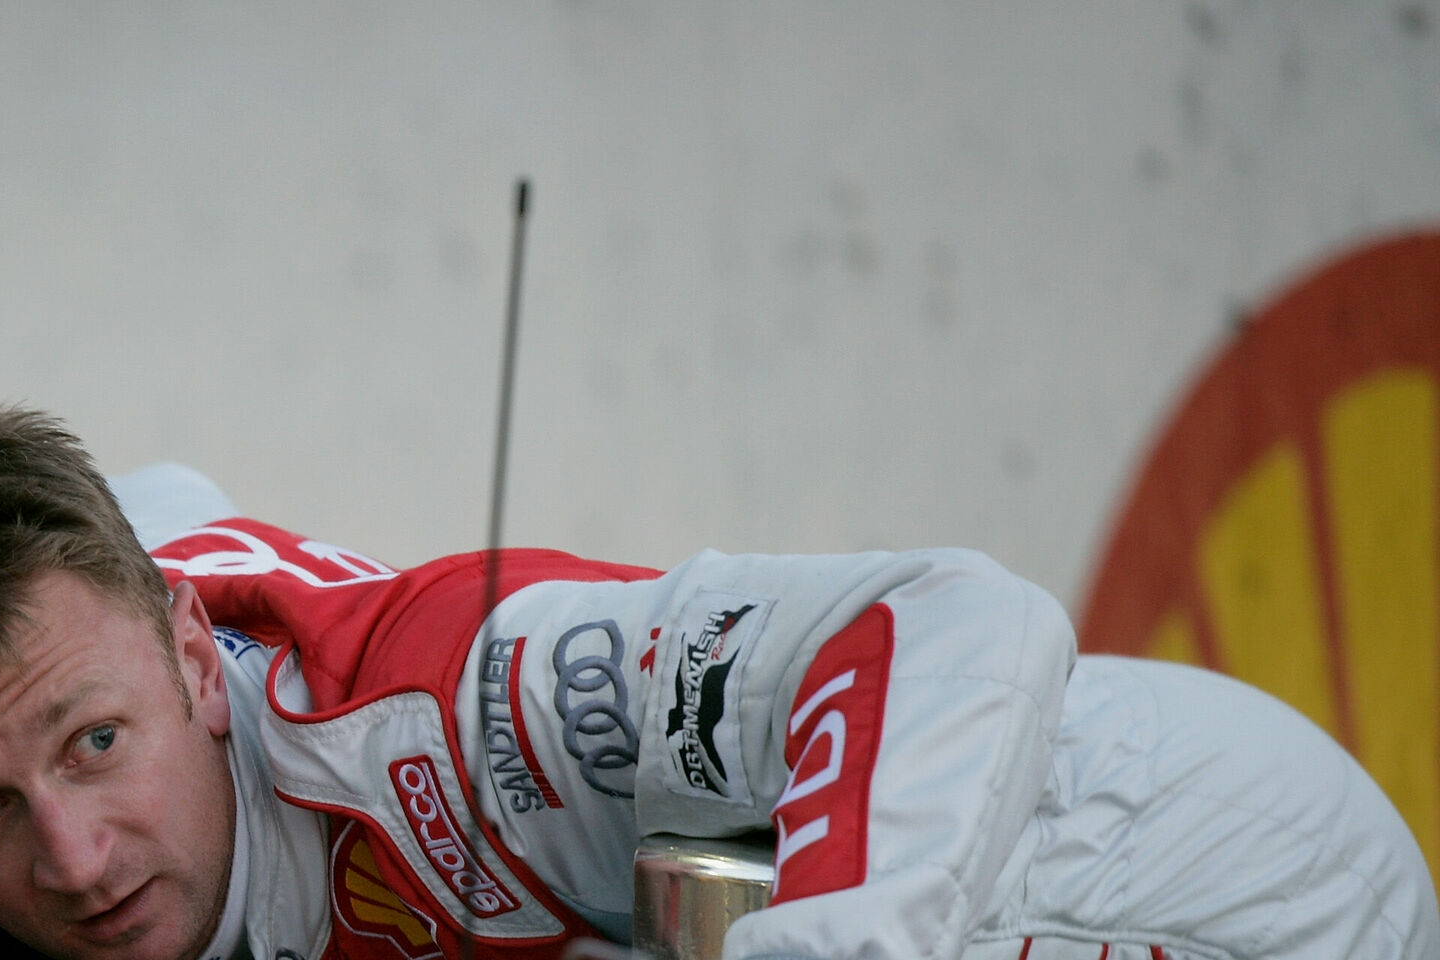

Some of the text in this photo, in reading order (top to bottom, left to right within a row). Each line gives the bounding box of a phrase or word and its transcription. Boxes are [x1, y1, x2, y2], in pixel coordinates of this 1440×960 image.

[480, 637, 546, 814] SANDTLER
[770, 668, 857, 897] TDI
[398, 762, 508, 913] sparco
